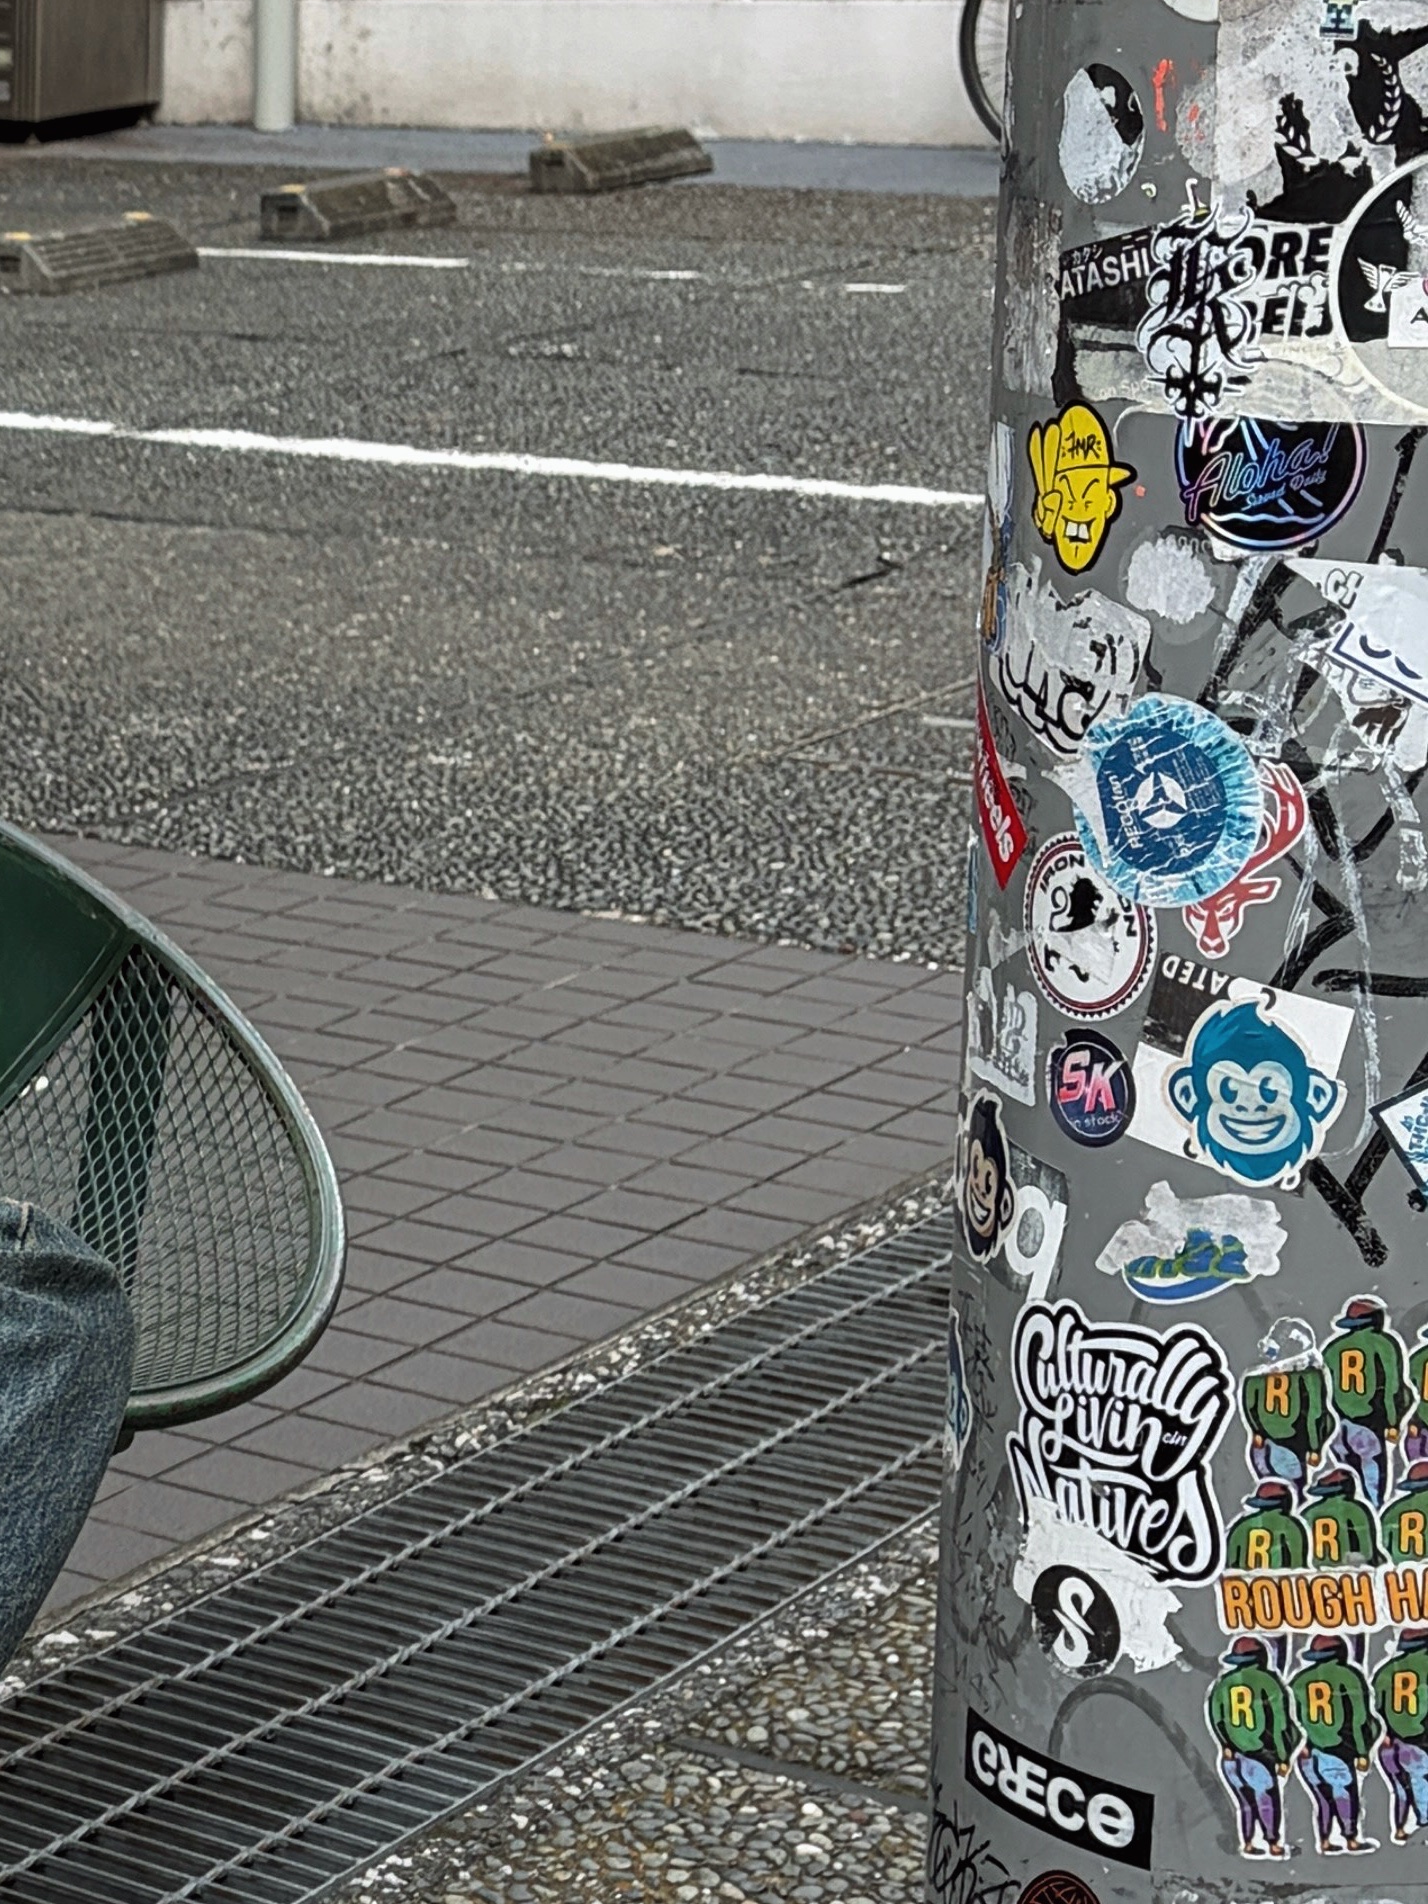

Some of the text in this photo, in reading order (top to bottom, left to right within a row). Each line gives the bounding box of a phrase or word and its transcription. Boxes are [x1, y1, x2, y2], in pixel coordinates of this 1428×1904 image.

[1040, 853, 1086, 894] IRON
[1019, 1313, 1221, 1481] Culturally
[1222, 1573, 1375, 1631] ROUGH
